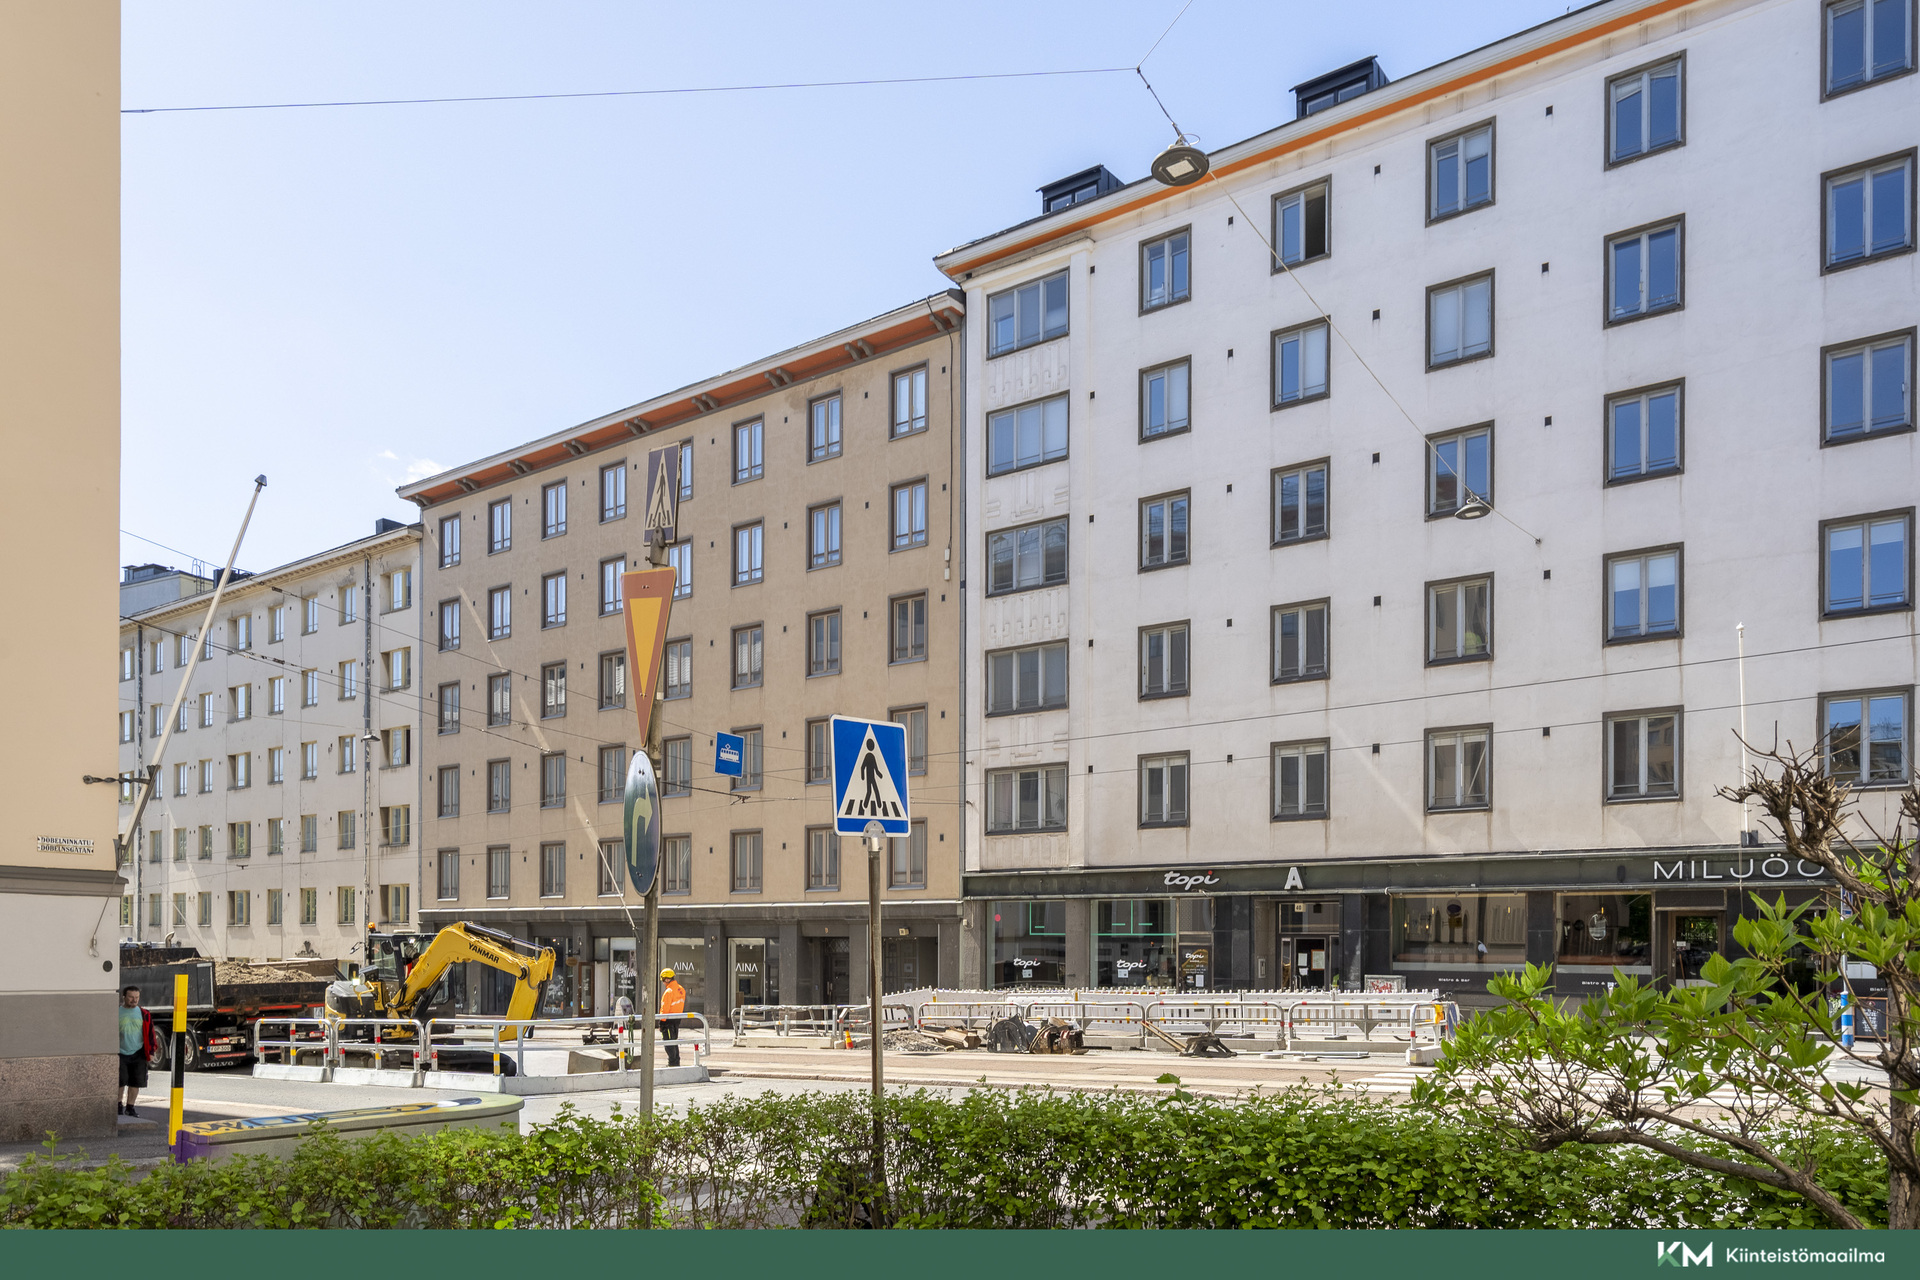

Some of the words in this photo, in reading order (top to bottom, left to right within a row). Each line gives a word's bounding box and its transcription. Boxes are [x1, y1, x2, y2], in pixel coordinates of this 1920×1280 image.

[1163, 870, 1220, 891] topi
[1283, 866, 1304, 890] A
[468, 942, 500, 964] YANMAR
[673, 961, 695, 971] AINA
[735, 962, 759, 973] AINA
[1013, 957, 1041, 969] topi
[1116, 958, 1147, 971] topi
